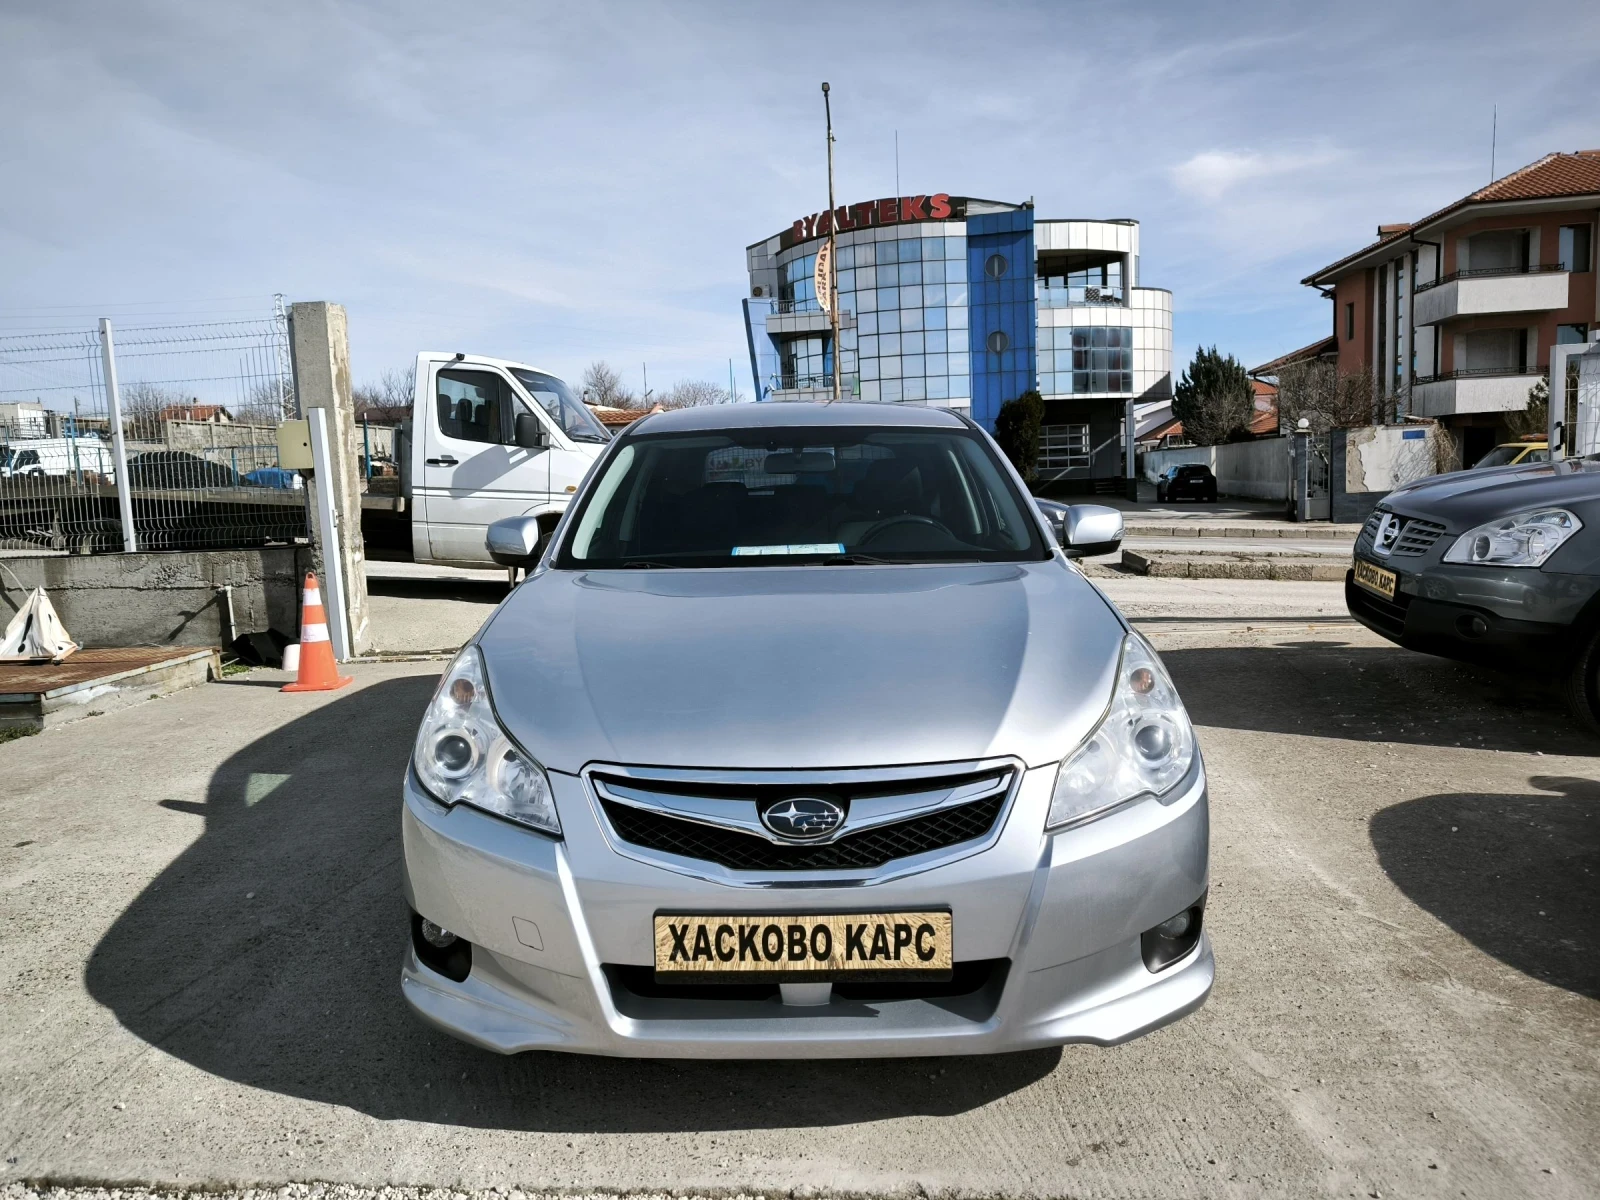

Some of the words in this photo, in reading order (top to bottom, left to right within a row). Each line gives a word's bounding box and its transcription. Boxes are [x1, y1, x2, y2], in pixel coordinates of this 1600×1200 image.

[793, 193, 952, 244] BYALTEKS
[668, 923, 833, 962] ХАСКОВО
[845, 923, 936, 962] КАРС
